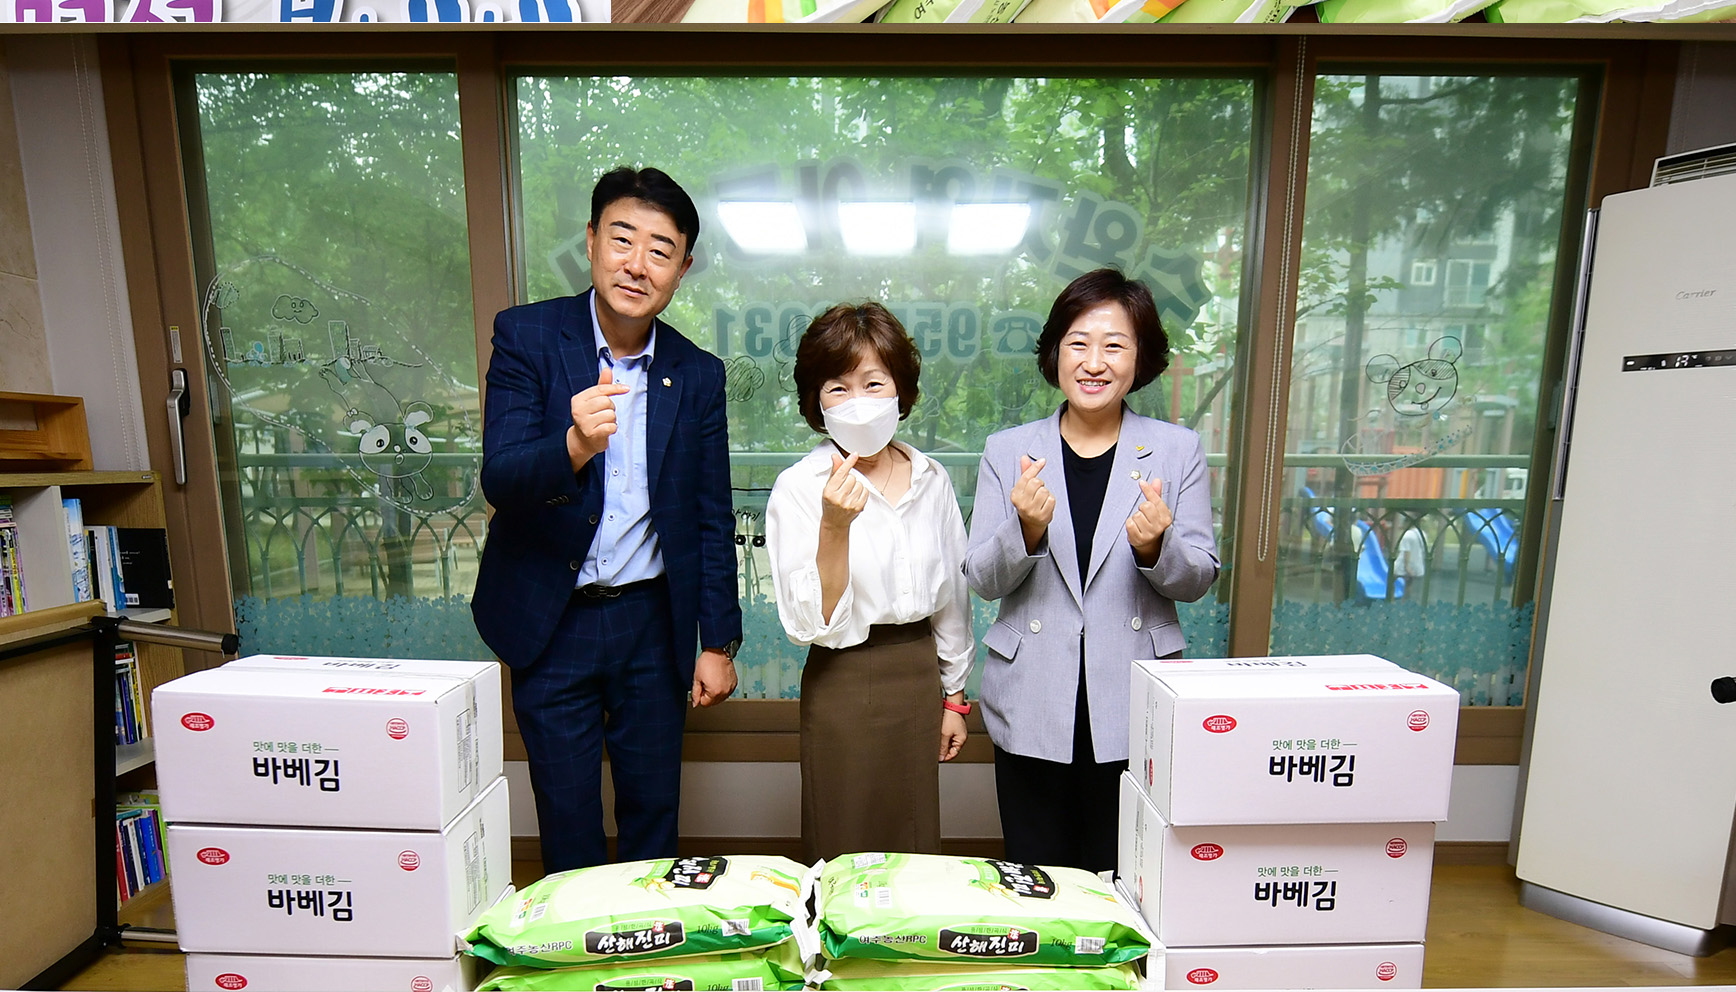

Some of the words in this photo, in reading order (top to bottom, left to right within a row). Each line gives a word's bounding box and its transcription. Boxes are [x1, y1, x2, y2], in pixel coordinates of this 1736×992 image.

[1675, 289, 1717, 300] Carrier
[253, 741, 273, 752] 맛에
[277, 742, 298, 753] 맛을
[301, 743, 322, 754] 더한
[1272, 739, 1293, 750] 맛에
[1296, 739, 1316, 750] 맛을
[1320, 739, 1341, 750] 더한
[252, 757, 340, 792] 바베김
[1269, 755, 1356, 787] 바베김
[1257, 866, 1277, 877] 맛에
[1280, 866, 1299, 876] 맛을
[1303, 865, 1322, 876] 더한
[267, 874, 288, 884] 맛에
[291, 874, 311, 885] 맛을
[315, 875, 335, 885] 더한
[1254, 880, 1337, 911] 바베김
[267, 889, 353, 922] 바베김
[697, 923, 719, 936] 10kg
[597, 931, 670, 954] 산해진미
[951, 937, 1024, 955] 산해진미
